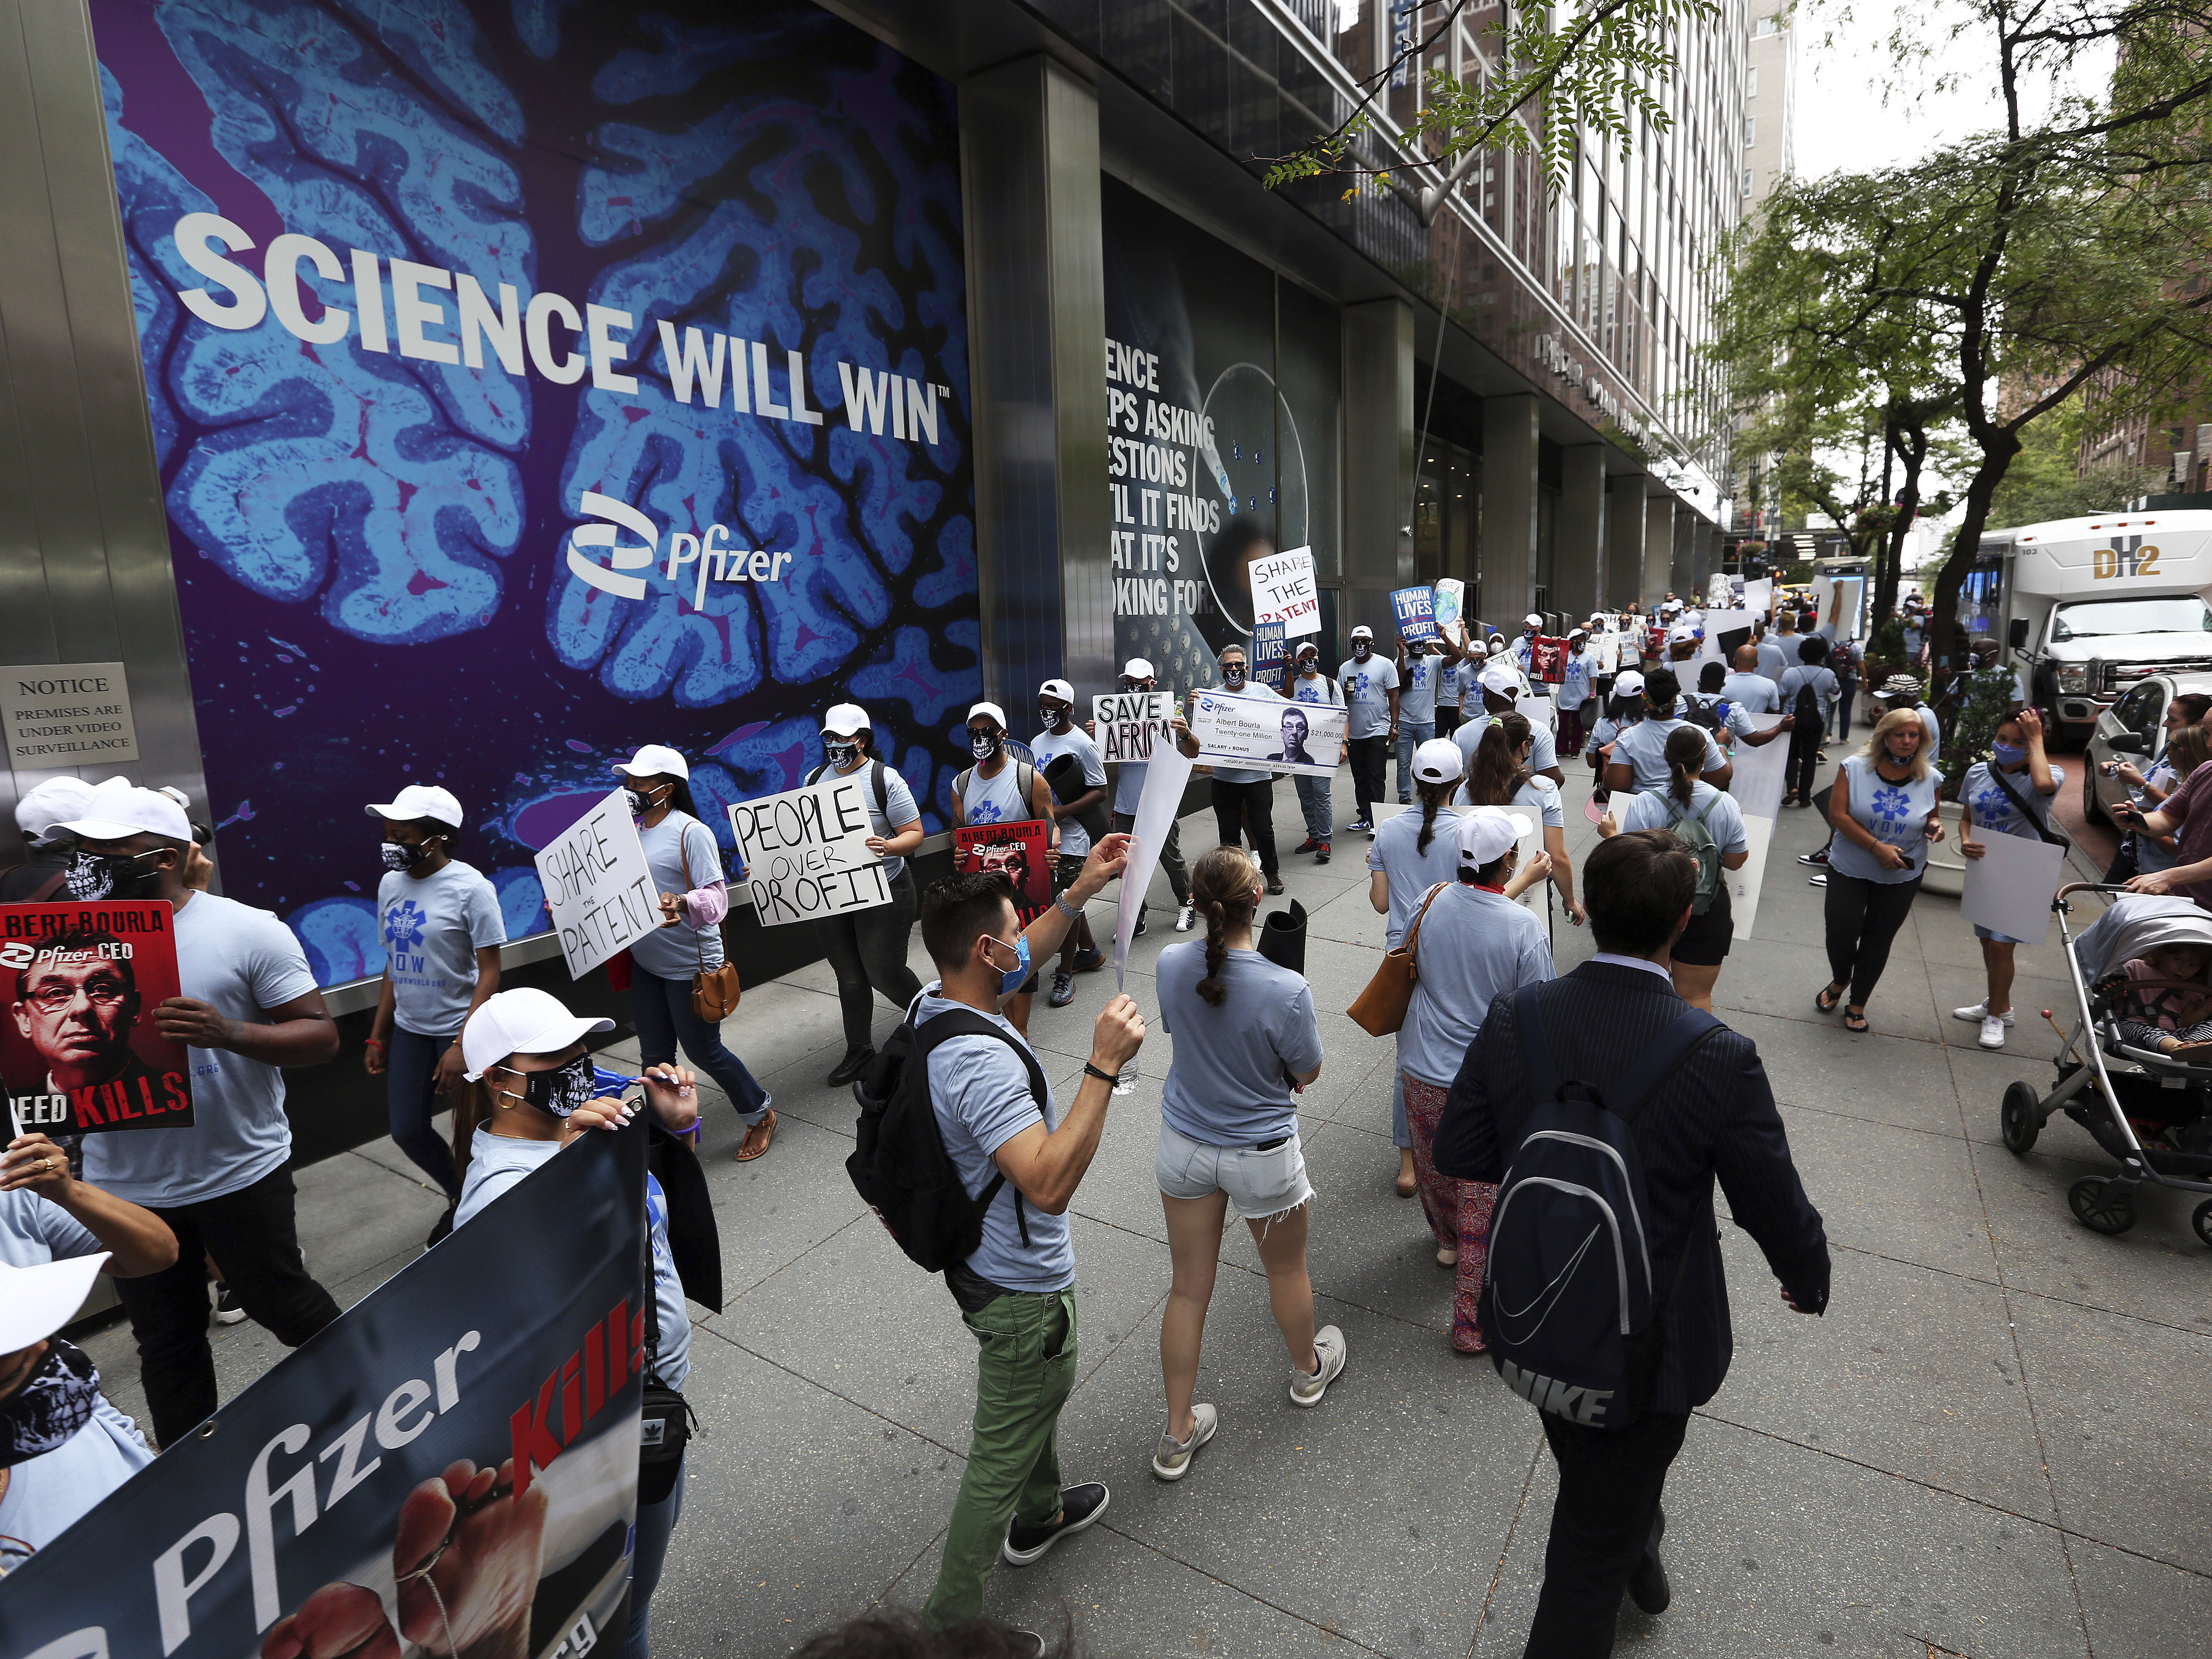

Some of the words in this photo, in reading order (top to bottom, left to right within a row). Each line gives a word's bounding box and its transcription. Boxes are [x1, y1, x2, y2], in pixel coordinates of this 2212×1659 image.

[174, 212, 638, 394] SCIENCE
[657, 319, 823, 425] WILL
[1107, 386, 1139, 432] PS
[1145, 399, 1215, 451] ASKING
[1109, 483, 1135, 523] IL
[1142, 488, 1161, 527] IT
[1167, 492, 1220, 534] FINDS
[1142, 533, 1180, 572] IT’S
[2094, 535, 2160, 579] DH2
[666, 524, 791, 611] Pfizer
[1255, 556, 1312, 583] SHARE
[1174, 580, 1213, 615] FOR.
[1268, 578, 1311, 604] THE
[1395, 589, 1431, 605] HUMAN
[1258, 598, 1317, 623] PATENT
[1397, 600, 1433, 620] LIVES
[1257, 625, 1283, 642] HUMAN
[1402, 621, 1435, 637] PROFIT
[1257, 640, 1284, 661] LIVES
[18, 678, 109, 695] NOTICE
[1255, 667, 1283, 683] PROFIT
[15, 707, 90, 720] PREMISES
[94, 705, 123, 715] ARE
[1098, 693, 1162, 724] SAVE
[1214, 703, 1236, 714] Pfizer
[19, 725, 74, 738] UNDER
[75, 722, 122, 733] VIDEO
[1215, 728, 1251, 737] Twenty-one
[1216, 718, 1236, 726] Albert
[1239, 721, 1260, 729] Bourla
[16, 738, 129, 756] SURVEILLANCE
[1104, 719, 1174, 760] AFRICA
[735, 785, 865, 863] PEOPLE
[962, 830, 997, 843] ALBERT
[1000, 825, 1041, 839] BOURLA
[1870, 819, 1906, 835] VOW
[546, 813, 617, 906] SHARE
[986, 844, 1008, 857] Pfizer
[1009, 842, 1026, 851] CEO
[771, 846, 845, 882] OVER
[583, 895, 594, 908] THE
[751, 862, 886, 926] PROFIT
[0, 913, 69, 939] BERT
[79, 910, 164, 934] BOURLA
[563, 874, 654, 973] PATENT
[1018, 904, 1050, 930] ILL
[37, 945, 93, 971] Pfizer
[98, 942, 134, 960] CEO
[10, 1094, 67, 1125] EED
[70, 1072, 188, 1128] KILLS
[1501, 1359, 1614, 1428] NIKE
[154, 1330, 481, 1658] Pfizer
